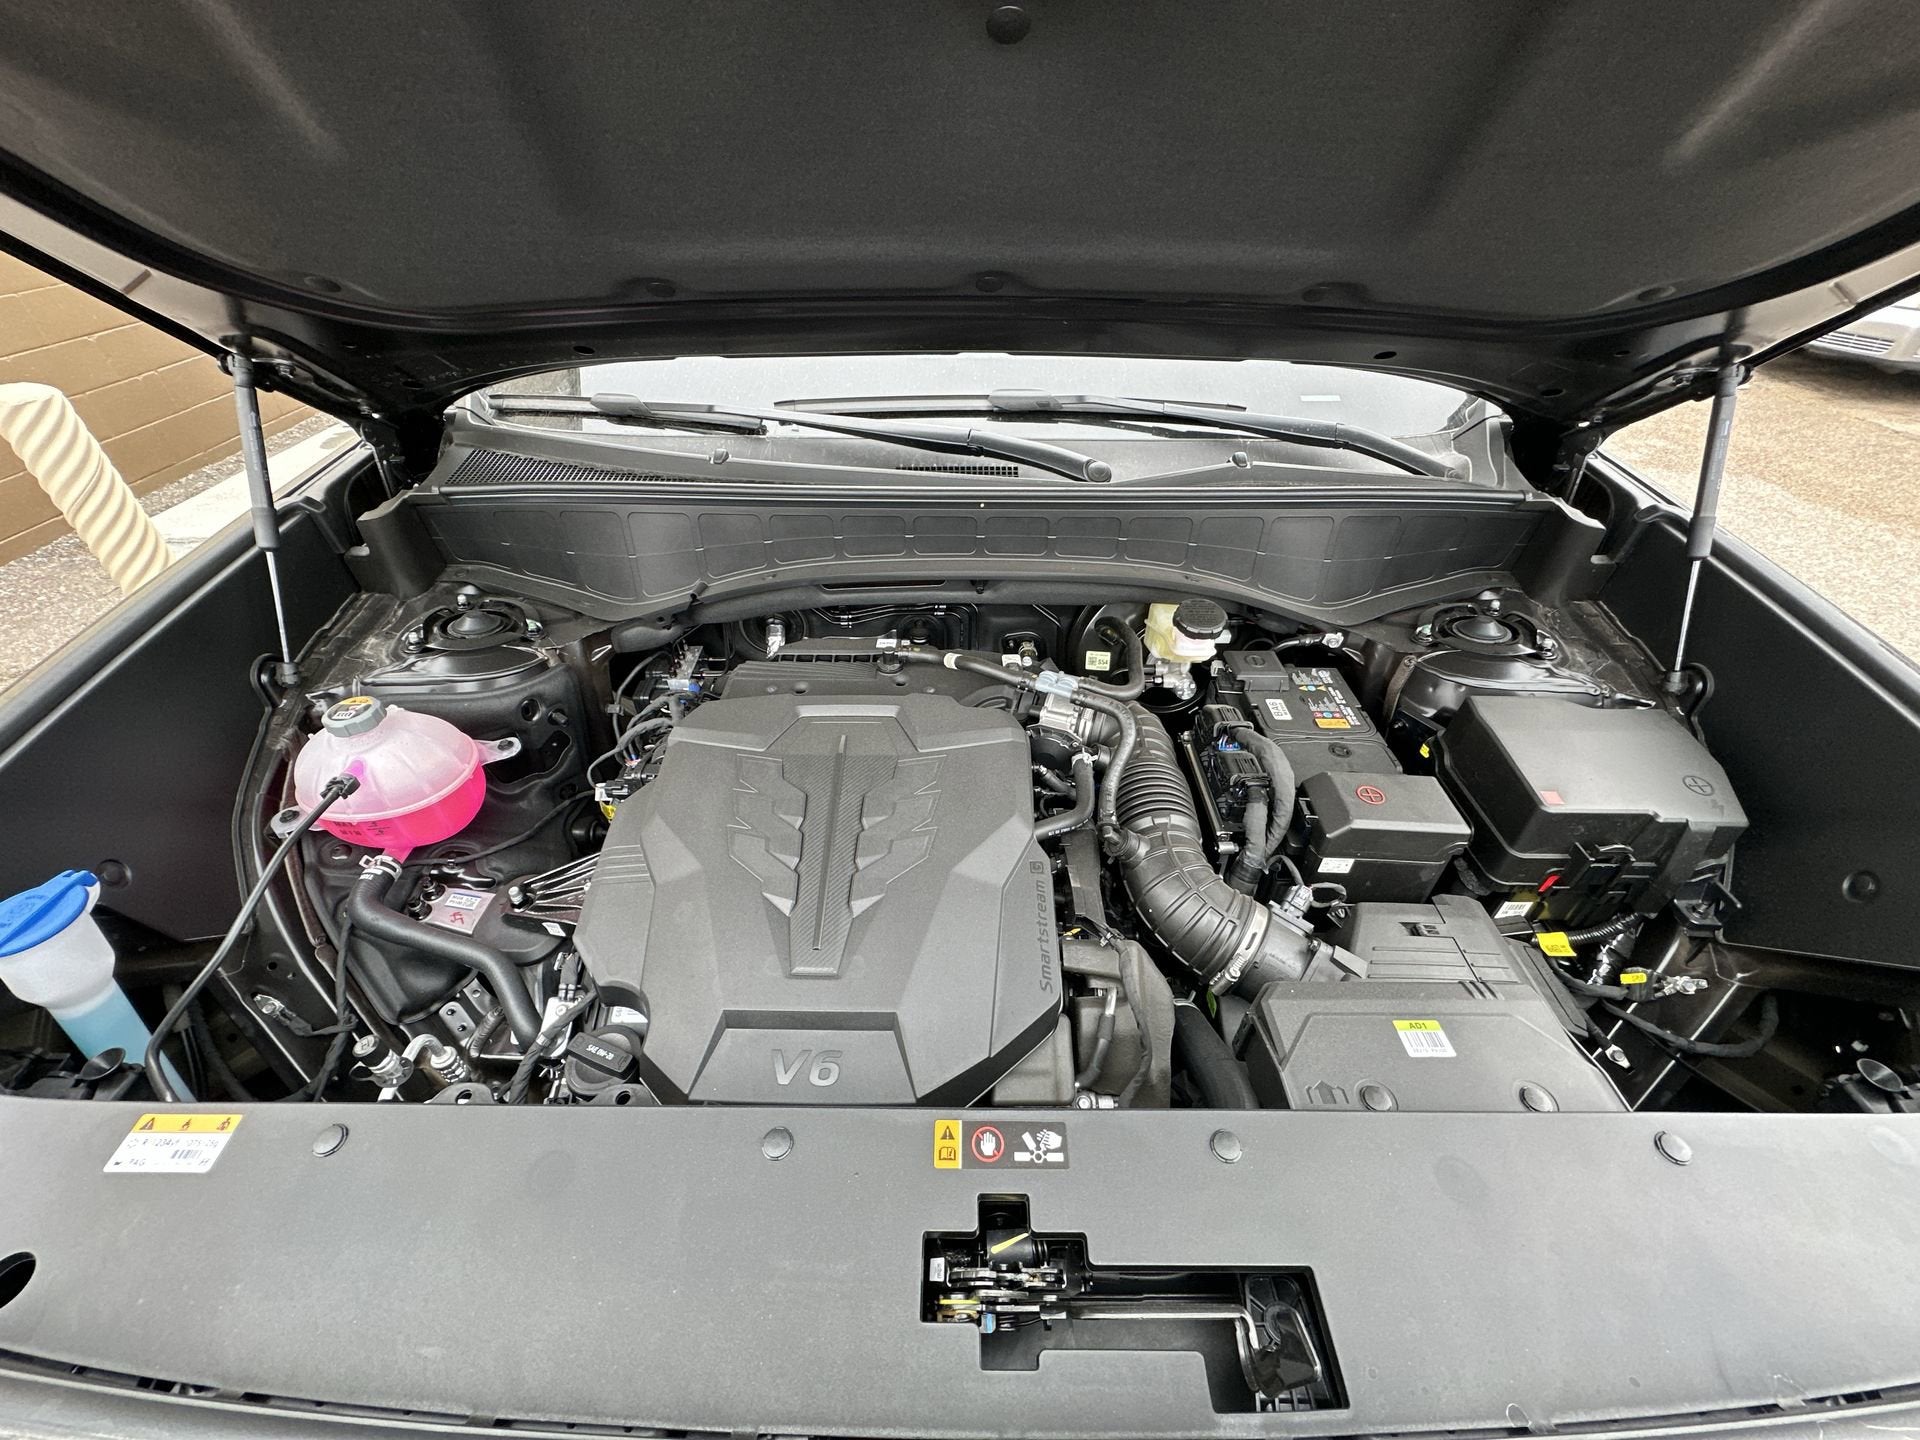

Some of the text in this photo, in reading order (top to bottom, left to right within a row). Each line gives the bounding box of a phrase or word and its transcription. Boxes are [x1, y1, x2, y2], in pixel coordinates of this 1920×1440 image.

[1036, 880, 1053, 994] Smartstream
[586, 1044, 599, 1053] SAE
[771, 1048, 843, 1087] V6
